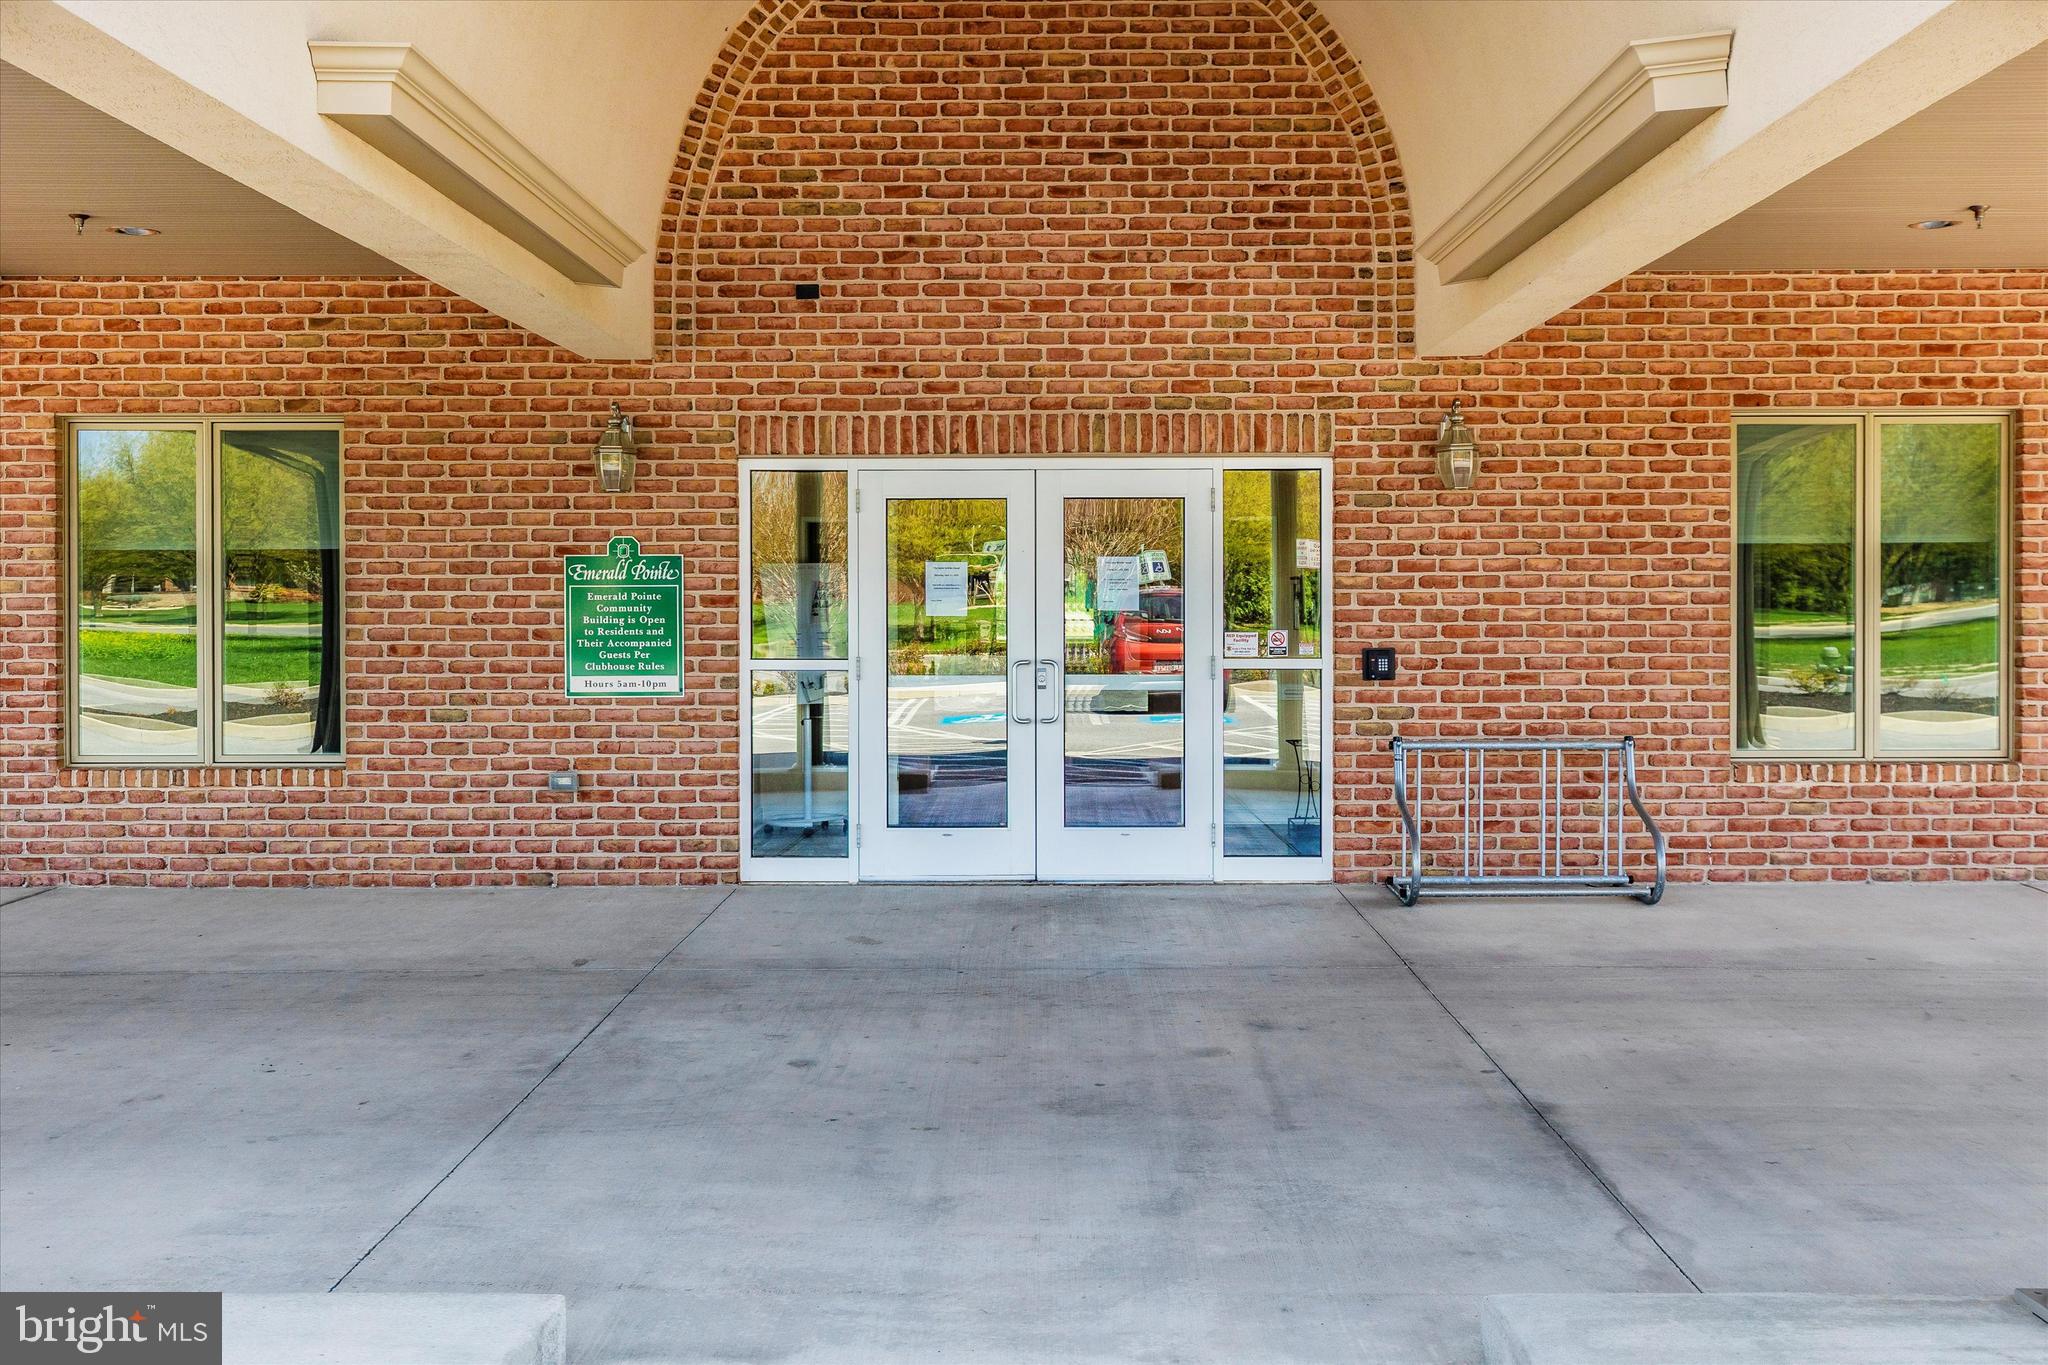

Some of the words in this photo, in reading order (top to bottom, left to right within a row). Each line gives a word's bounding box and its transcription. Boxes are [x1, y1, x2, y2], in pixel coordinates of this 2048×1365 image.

[568, 559, 633, 581] Emerald
[631, 559, 680, 580] Pointe
[587, 592, 627, 601] Emerald
[631, 592, 662, 601] Pointe
[596, 604, 652, 614] Community
[583, 615, 625, 626] Building
[628, 615, 636, 624] is
[639, 615, 666, 626] Open
[584, 628, 594, 636] to
[597, 627, 644, 636] Residents
[646, 627, 664, 636] and
[577, 639, 603, 648] Their
[607, 638, 672, 649] Accompanied
[599, 650, 631, 659] Guests
[634, 650, 651, 659] Per
[585, 662, 636, 671] Clubhouse
[638, 662, 665, 671] Rules
[585, 680, 614, 688] Hours
[617, 680, 667, 690] 5am-10pm
